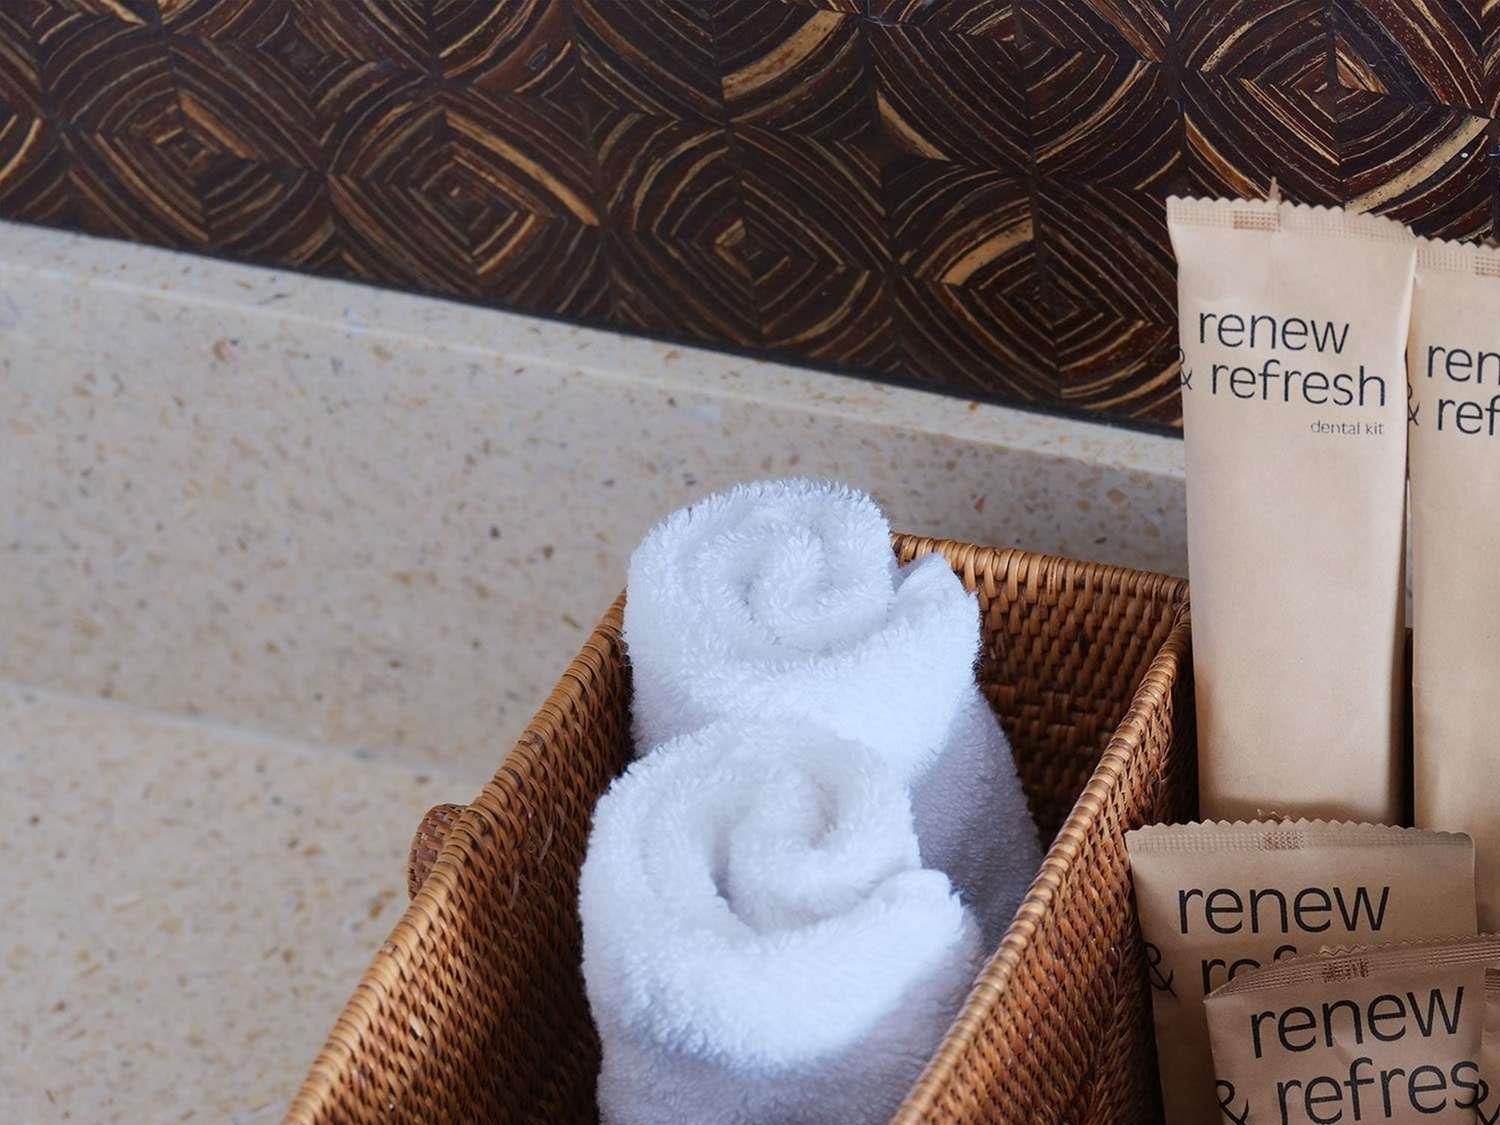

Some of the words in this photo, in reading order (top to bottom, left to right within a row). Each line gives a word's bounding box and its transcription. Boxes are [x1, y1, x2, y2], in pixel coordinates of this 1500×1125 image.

[1199, 312, 1350, 354] renew
[1211, 358, 1386, 407] refresh
[1310, 420, 1360, 436] dental
[1365, 421, 1385, 436] kit
[1177, 886, 1390, 934] renew
[1251, 986, 1464, 1059] renew
